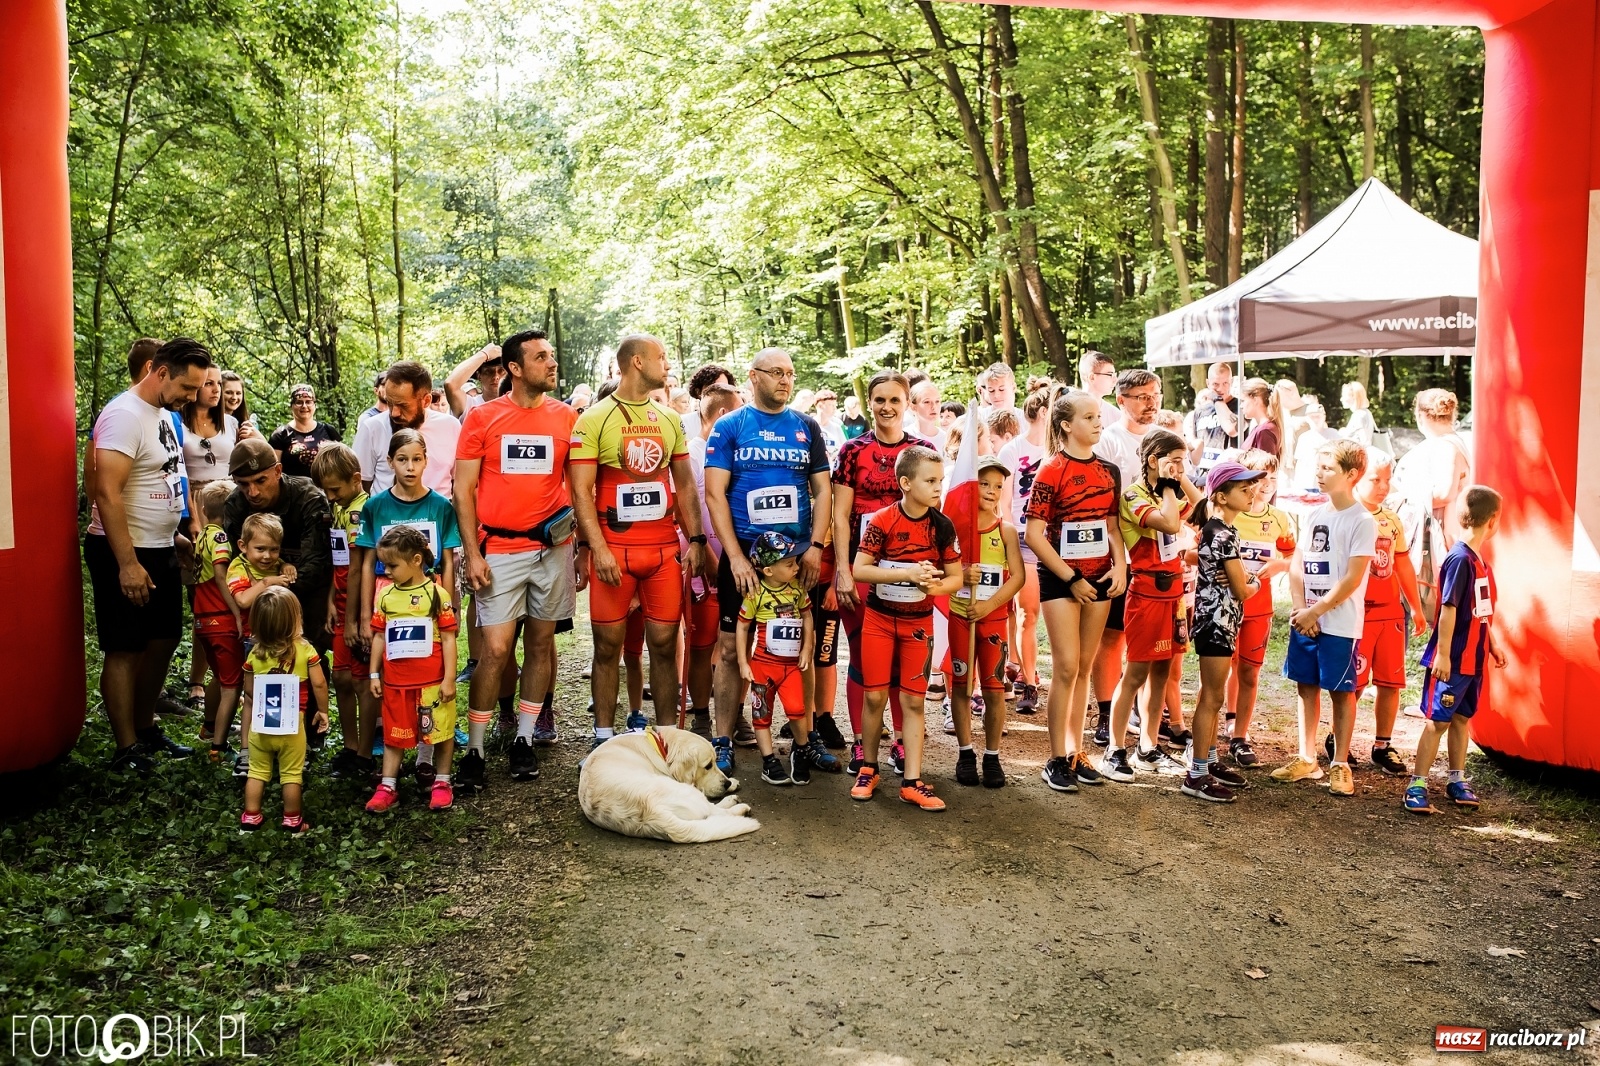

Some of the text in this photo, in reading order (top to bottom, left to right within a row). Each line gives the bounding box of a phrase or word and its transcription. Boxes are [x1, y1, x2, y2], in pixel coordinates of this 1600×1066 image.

[1368, 310, 1476, 331] www.racib
[517, 446, 536, 458] 76
[633, 493, 651, 505] 80
[760, 496, 787, 509] 112
[1078, 529, 1095, 542] 83
[1305, 562, 1319, 574] 16
[395, 627, 414, 640] 77
[780, 627, 802, 639] 113
[819, 620, 837, 662] MINION
[266, 696, 280, 717] 14
